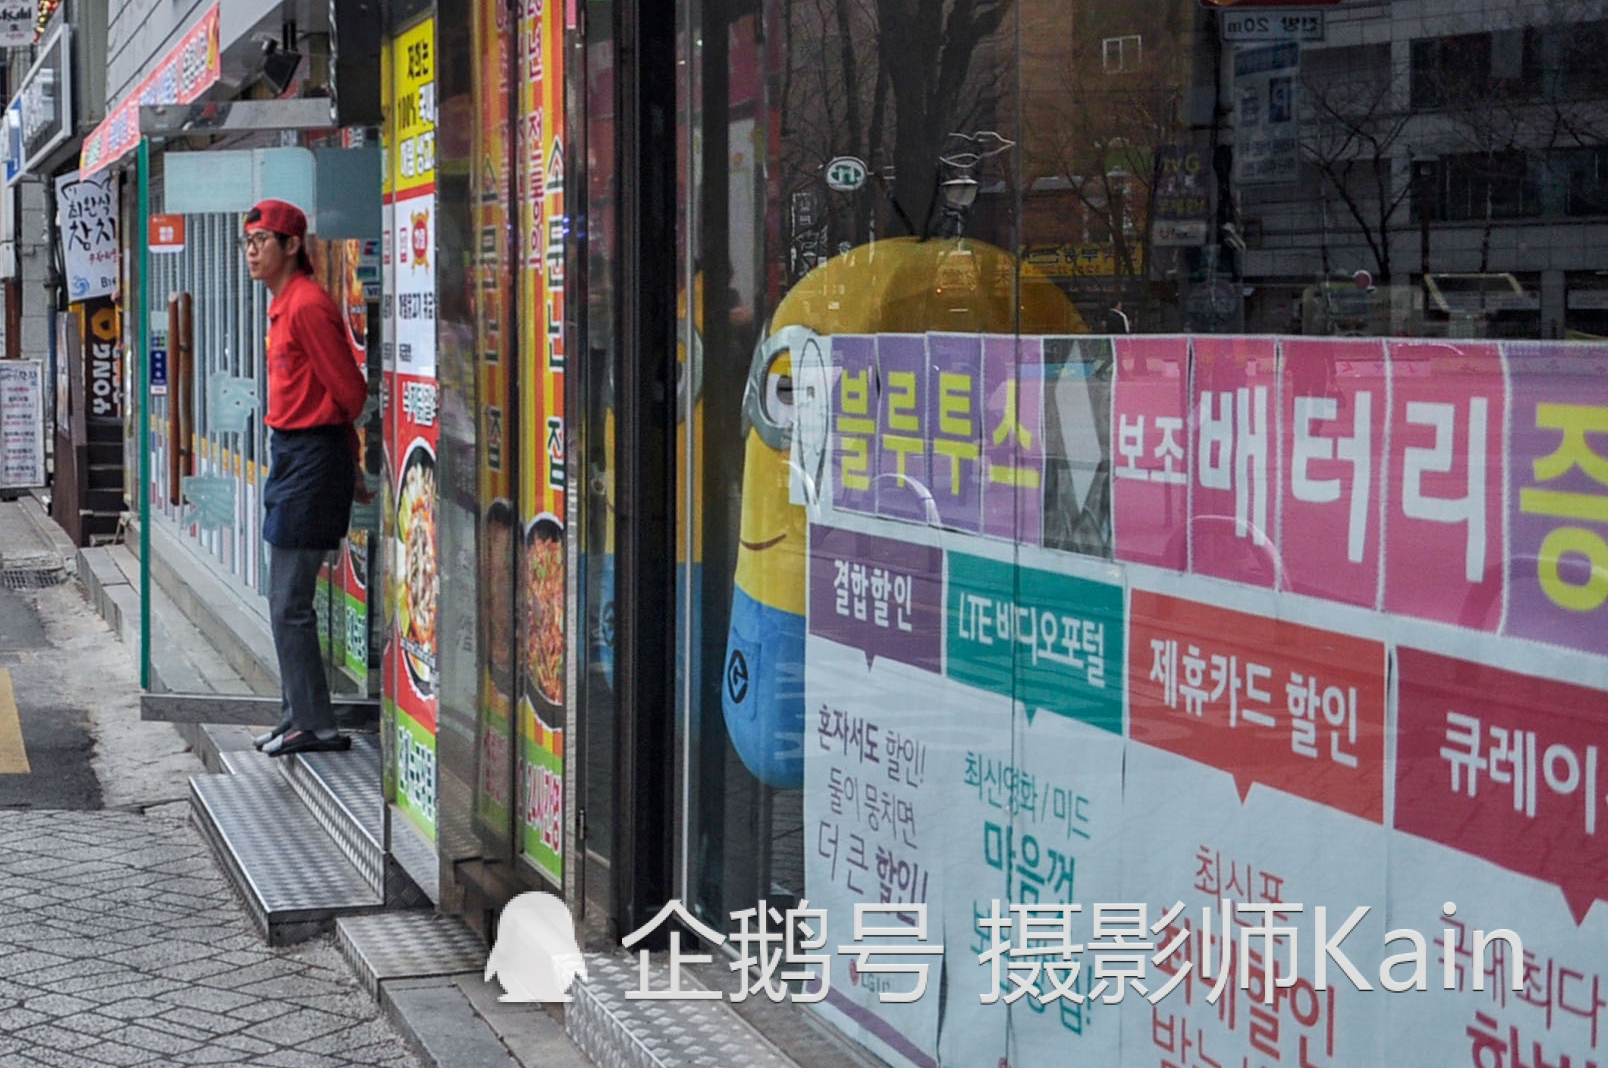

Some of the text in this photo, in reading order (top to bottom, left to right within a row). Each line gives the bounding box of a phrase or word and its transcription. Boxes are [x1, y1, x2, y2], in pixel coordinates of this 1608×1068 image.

[835, 369, 1042, 496] 블루투스
[833, 559, 913, 632] 결합할인
[817, 704, 880, 764] 혼자서도
[1149, 638, 1358, 769] 제휴카드 할인
[1440, 712, 1608, 835] 큐레이
